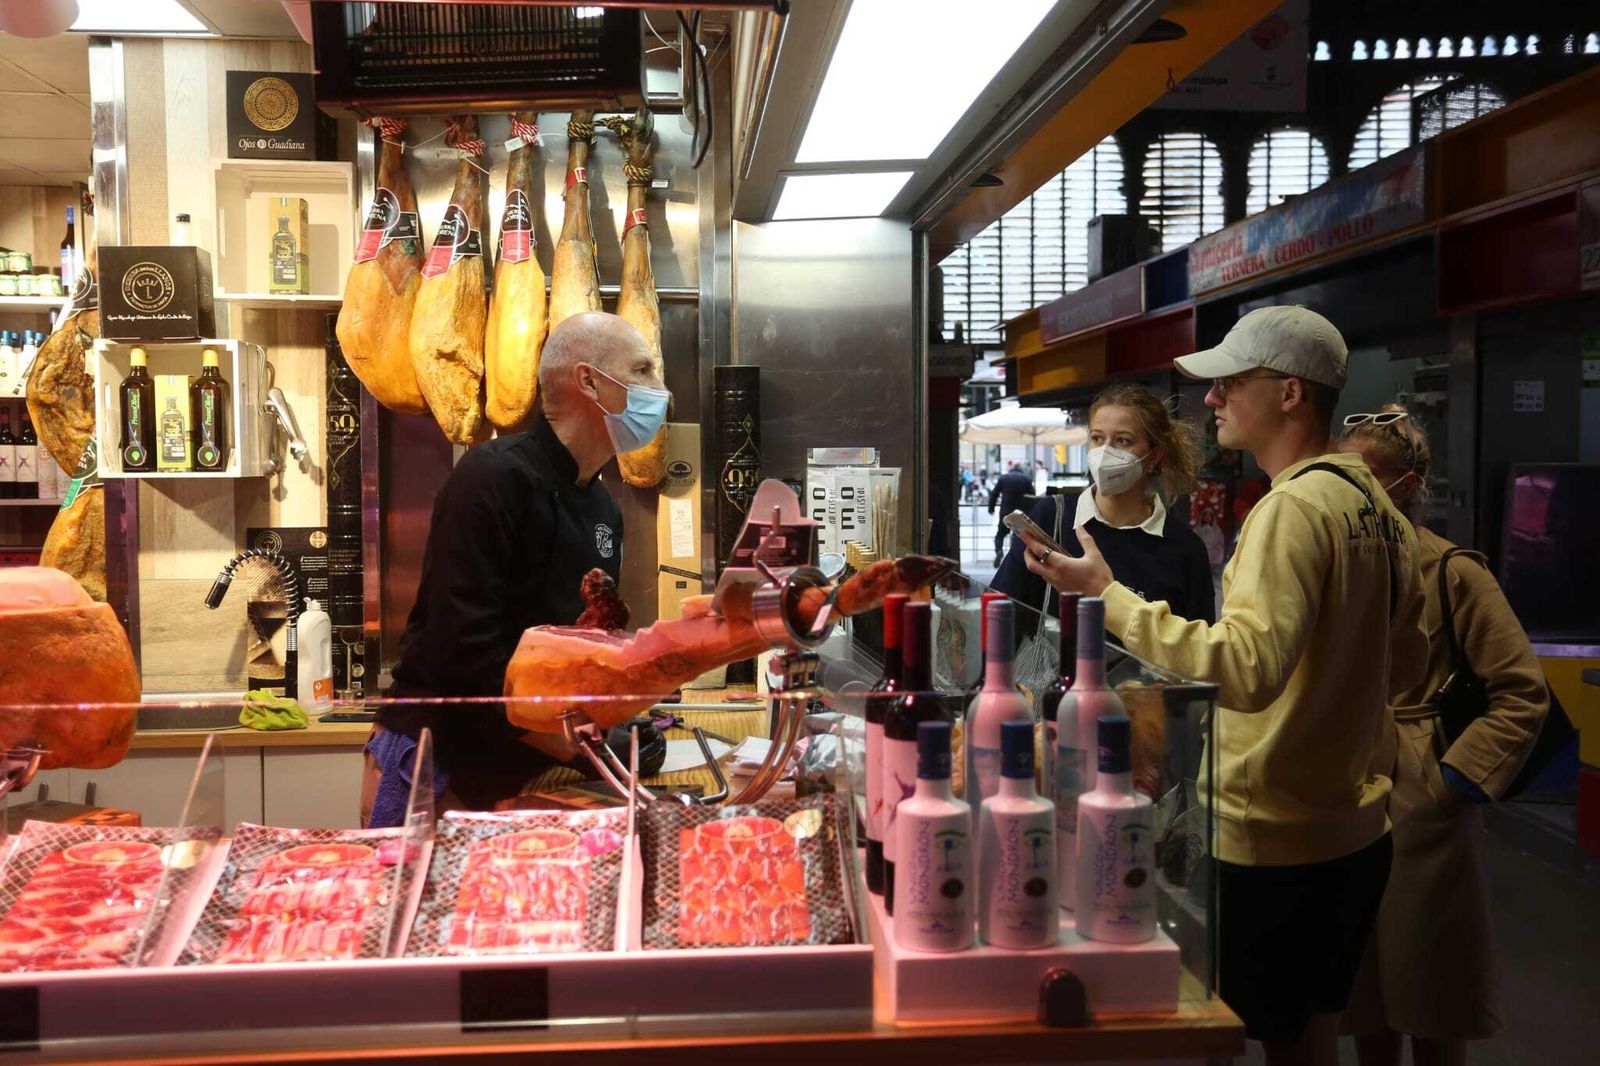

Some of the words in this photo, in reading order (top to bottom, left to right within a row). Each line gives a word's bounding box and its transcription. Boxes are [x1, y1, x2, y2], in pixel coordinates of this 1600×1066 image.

[238, 138, 256, 151] Ojos
[267, 138, 305, 150] Guadiana
[1221, 254, 1266, 284] TERNERA
[1275, 236, 1316, 265] CERDO
[1328, 213, 1376, 248] POLLO
